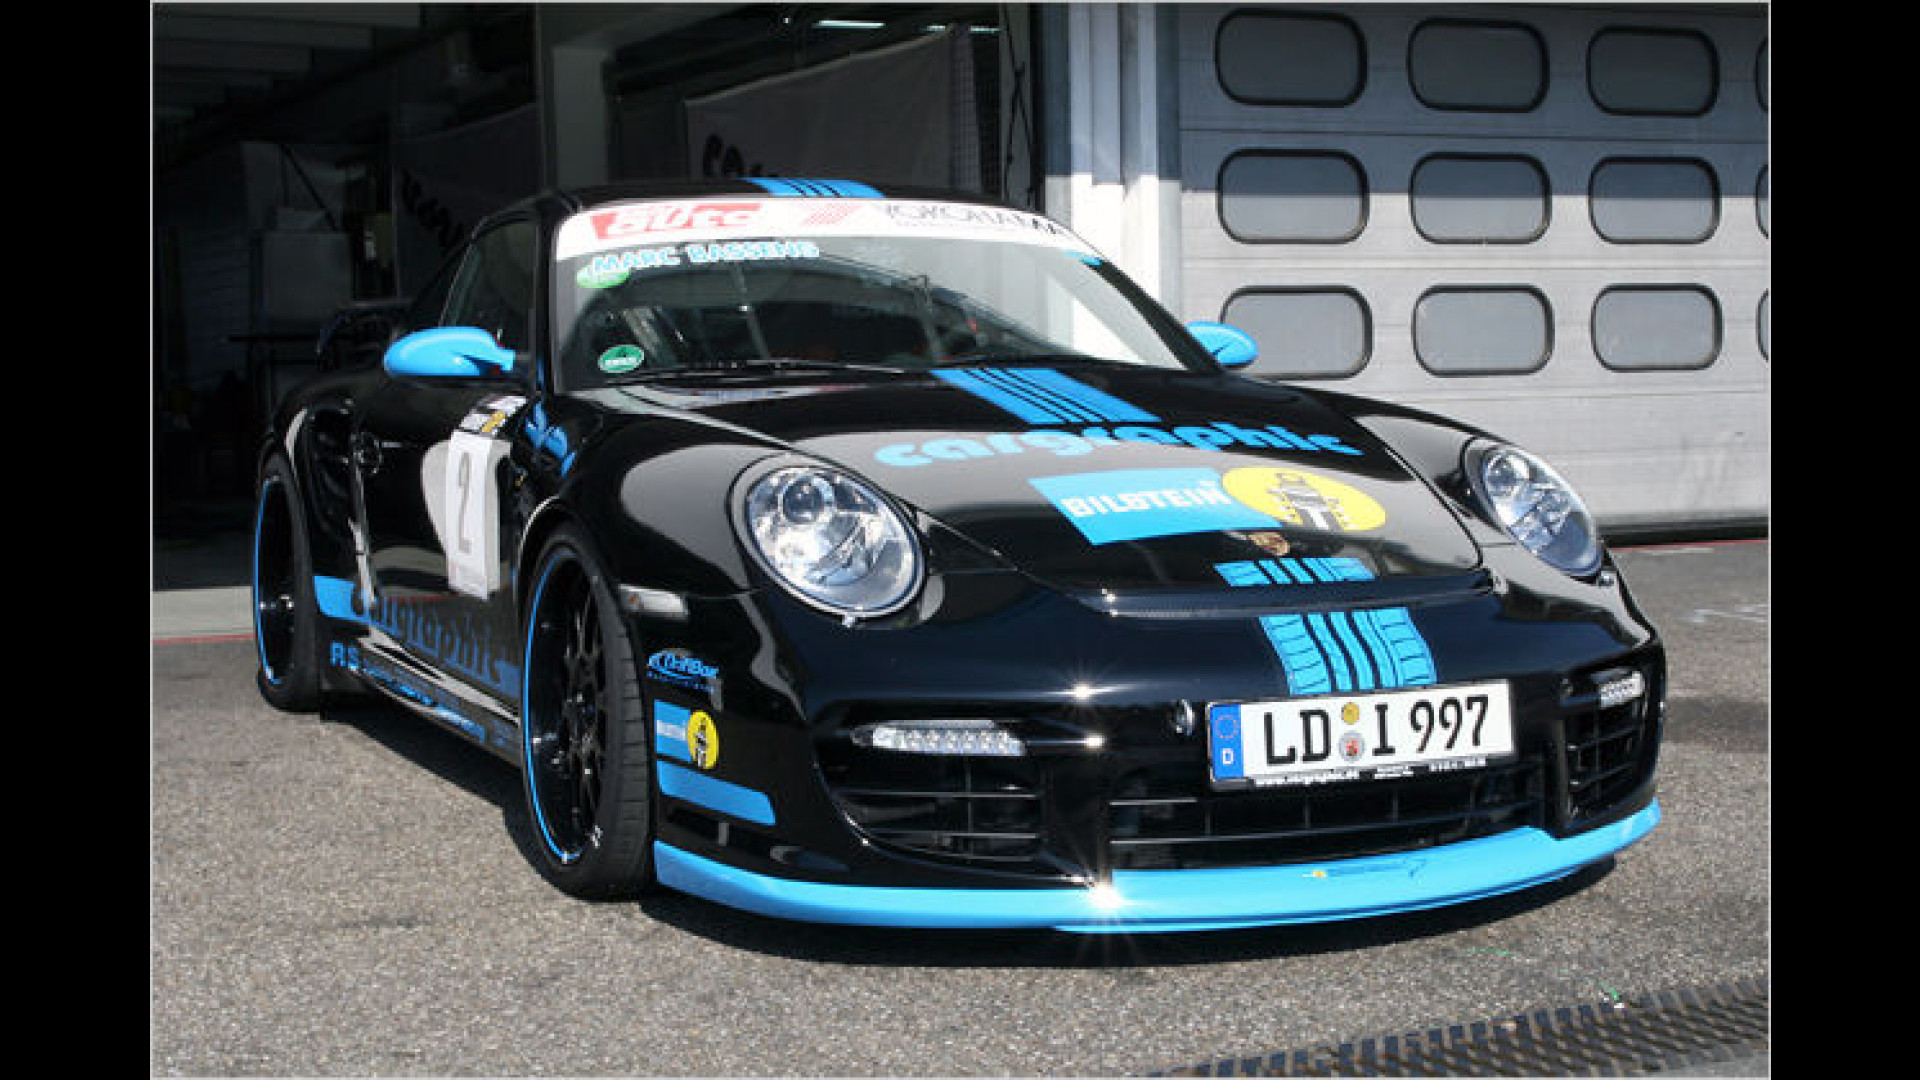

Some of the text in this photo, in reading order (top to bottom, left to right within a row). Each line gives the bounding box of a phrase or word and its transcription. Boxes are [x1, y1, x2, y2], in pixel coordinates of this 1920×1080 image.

[591, 248, 682, 275] MARC
[874, 424, 1364, 468] cargraphic
[458, 452, 472, 553] 2
[1058, 483, 1231, 518] BILSTEIN
[1263, 709, 1332, 765] LD
[1410, 694, 1489, 753] 997
[1222, 748, 1235, 764] D
